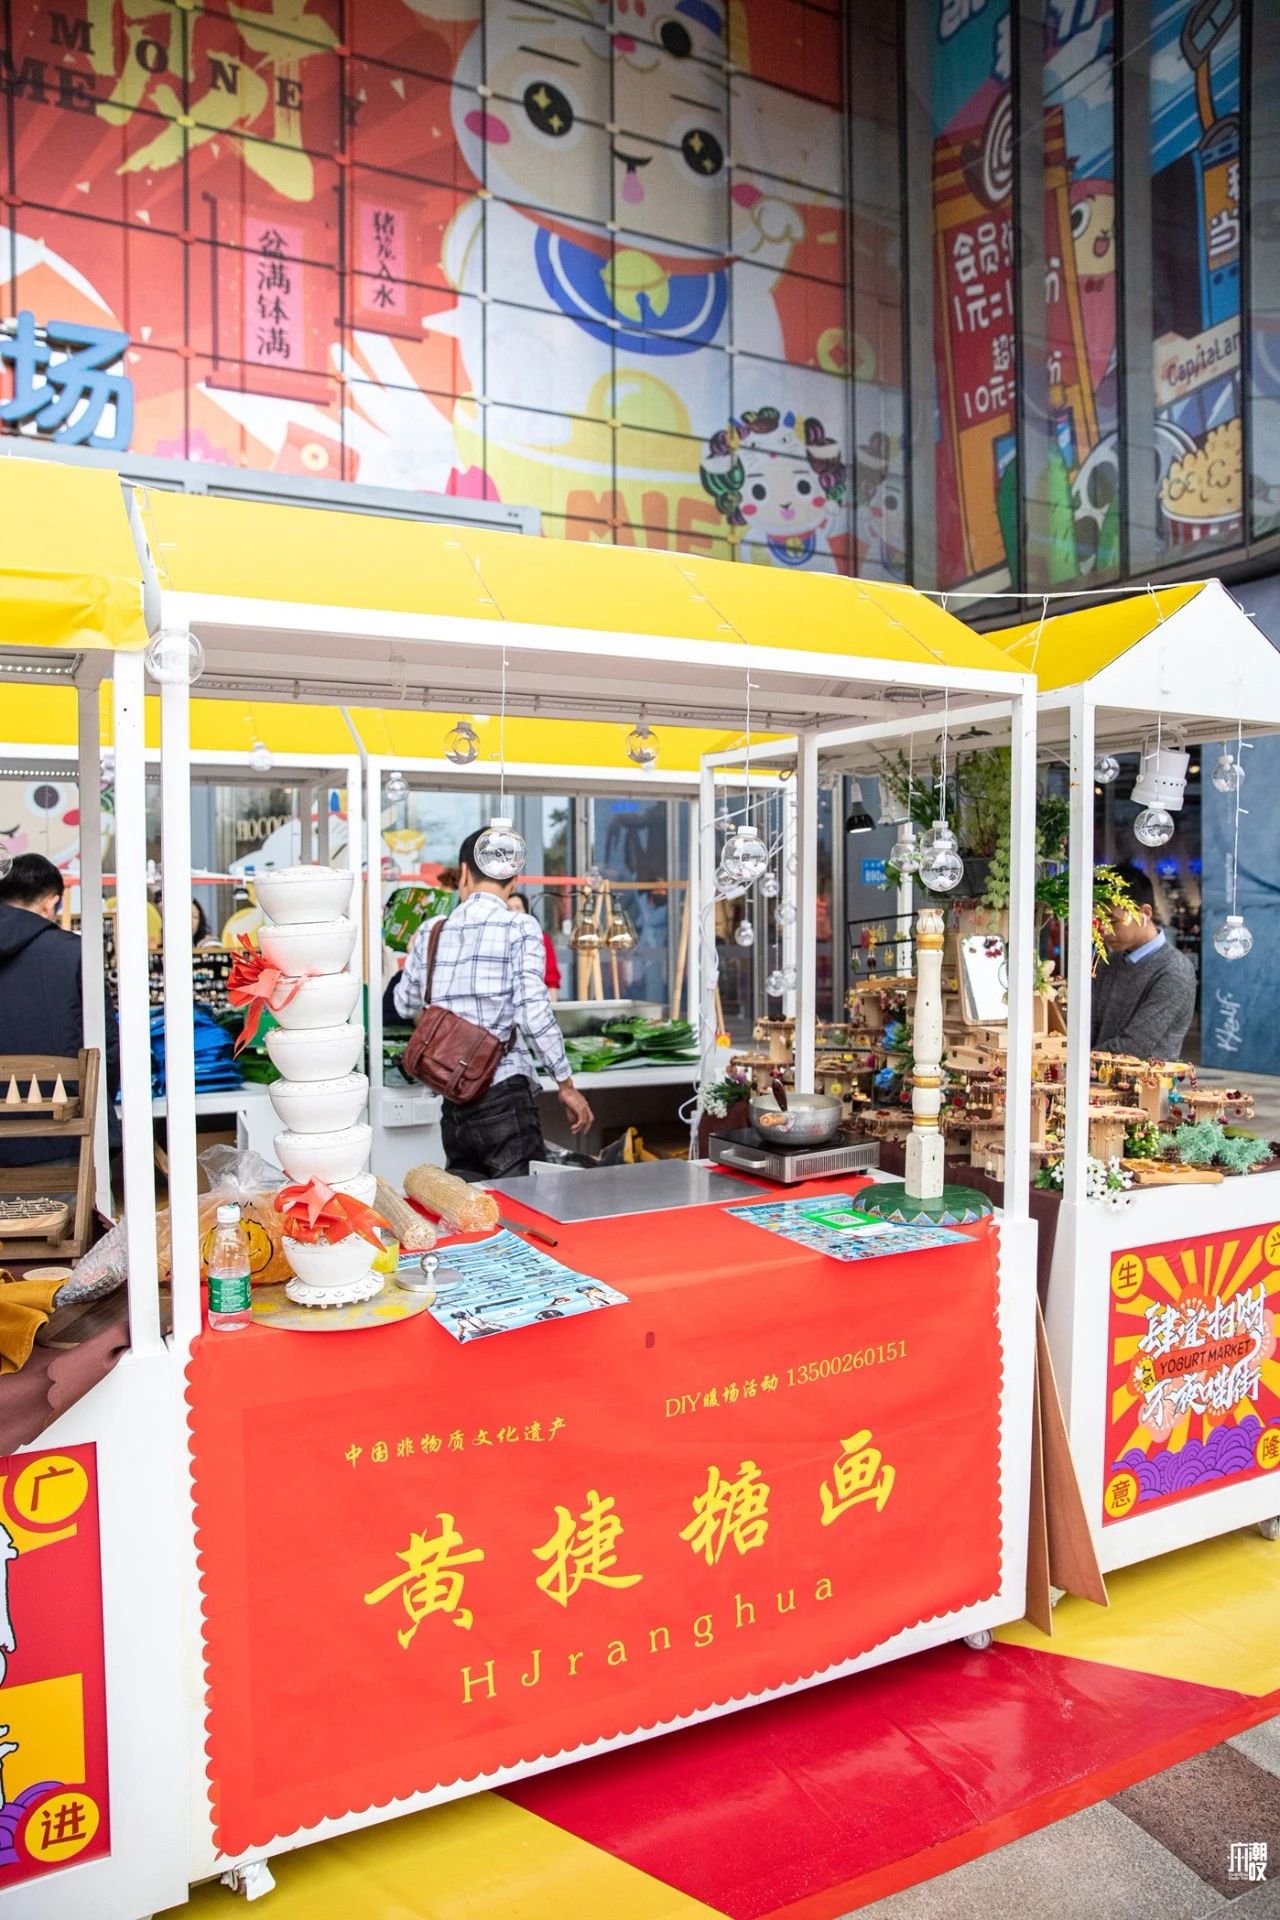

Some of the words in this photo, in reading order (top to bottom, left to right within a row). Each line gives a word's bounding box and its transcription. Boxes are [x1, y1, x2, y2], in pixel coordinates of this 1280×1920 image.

[0, 311, 134, 453] 场
[1117, 1261, 1138, 1290] 生
[786, 1339, 908, 1388] 13500260151
[1160, 1352, 1209, 1375] YOGURT
[1208, 1339, 1251, 1363] MARKET
[343, 1416, 567, 1470] 中国非物质文化遗产
[31, 1465, 75, 1512] 广
[1111, 1480, 1131, 1510] 意
[364, 1429, 896, 1649] 黄捷糖画
[40, 1800, 87, 1851] 进
